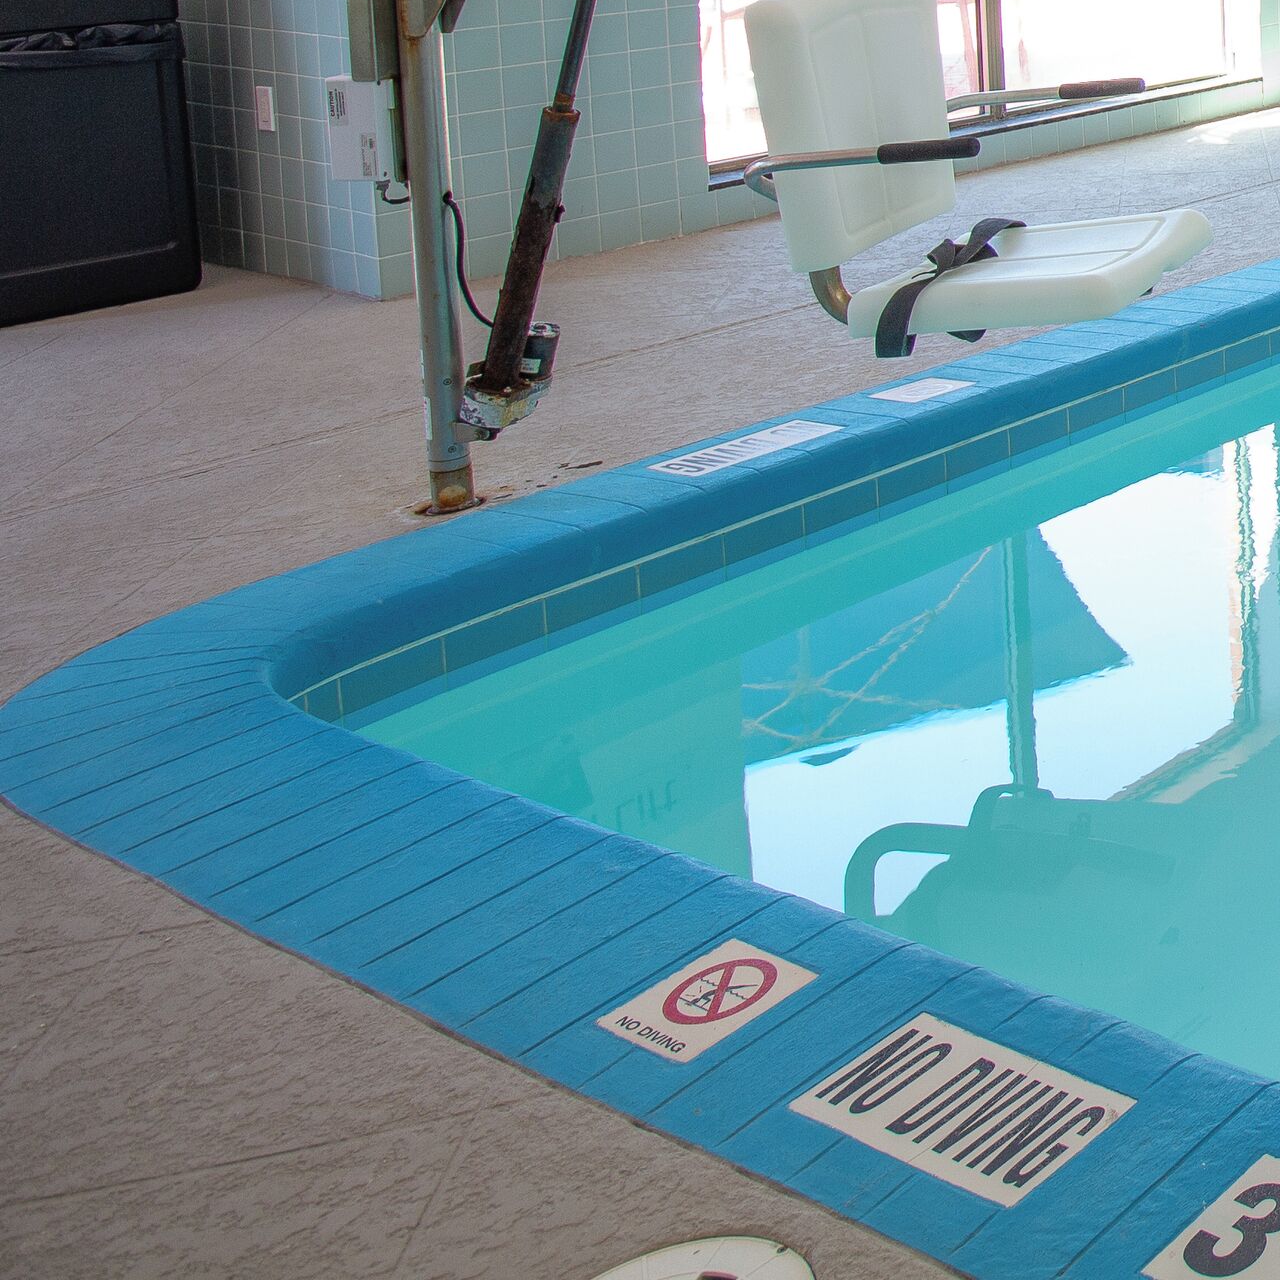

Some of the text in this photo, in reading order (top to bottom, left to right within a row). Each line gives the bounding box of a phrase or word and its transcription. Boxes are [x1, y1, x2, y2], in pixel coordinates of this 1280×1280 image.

[615, 1016, 686, 1053] NO DIVING
[815, 1029, 1105, 1188] NO DIVING
